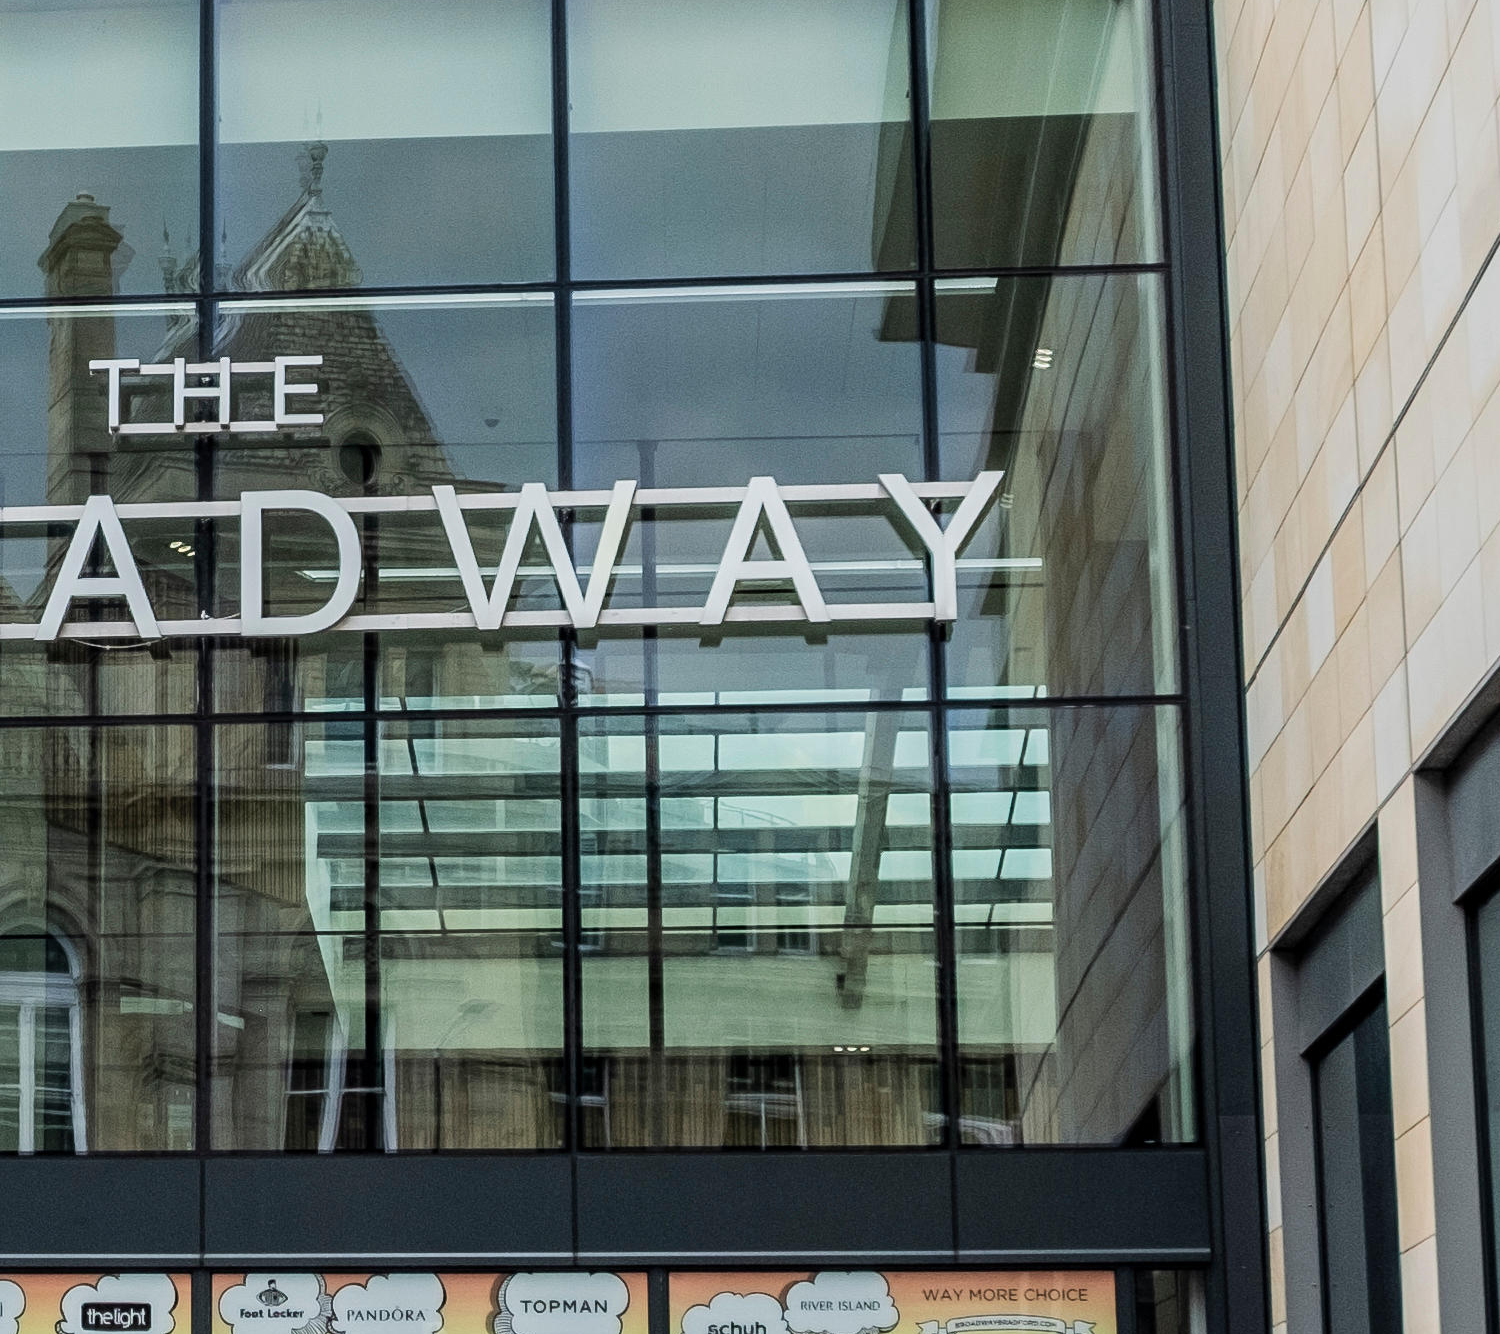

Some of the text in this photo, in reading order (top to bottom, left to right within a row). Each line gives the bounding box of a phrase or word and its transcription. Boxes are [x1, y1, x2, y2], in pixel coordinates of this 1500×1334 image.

[89, 354, 324, 436] THE
[923, 1288, 1089, 1303] WAY MORE CHOICE
[239, 1307, 305, 1320] Foot Locker
[519, 1299, 609, 1314] TOPMAN
[800, 1300, 881, 1312] RIVER ISLAND
